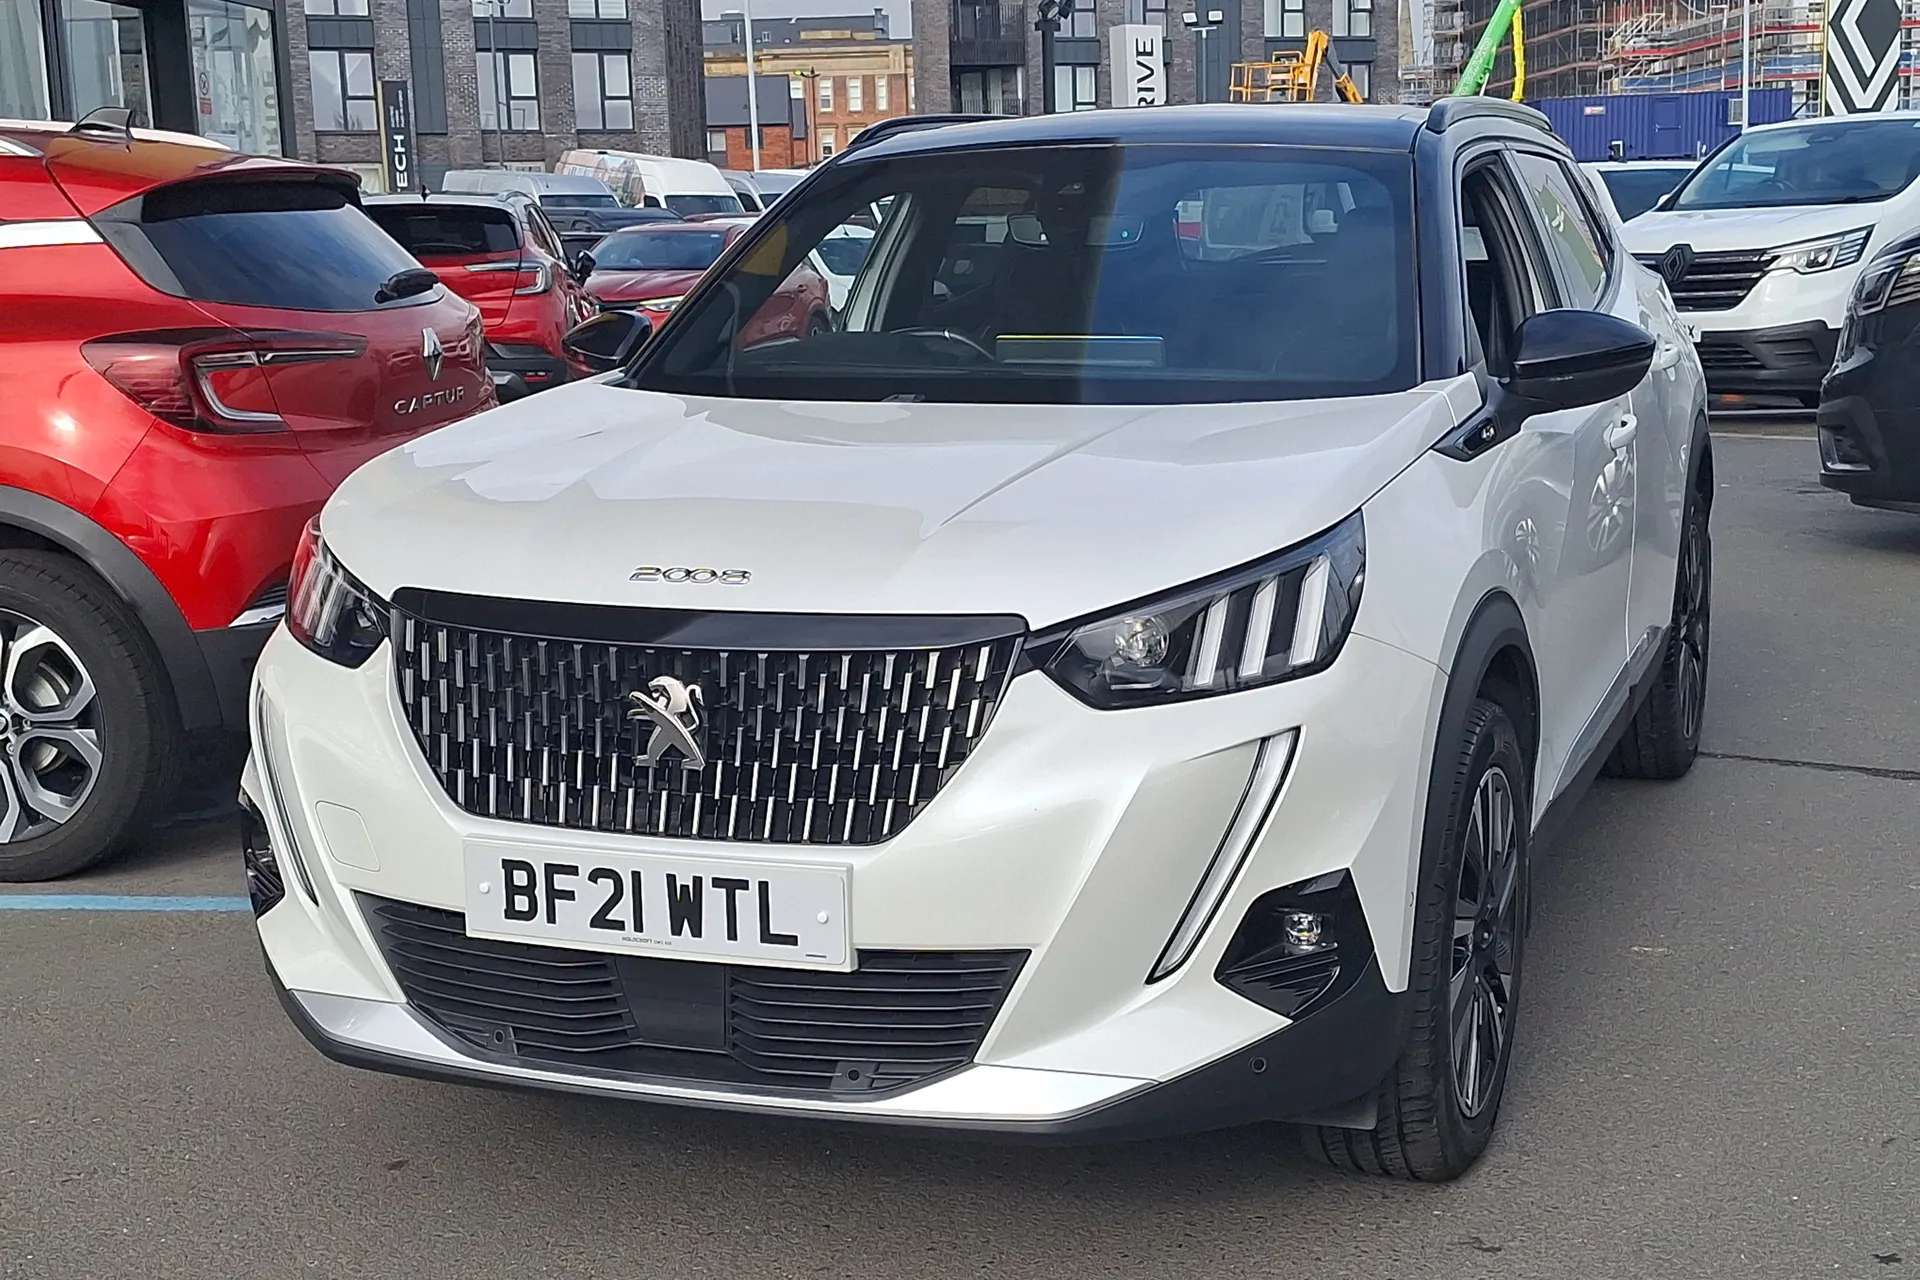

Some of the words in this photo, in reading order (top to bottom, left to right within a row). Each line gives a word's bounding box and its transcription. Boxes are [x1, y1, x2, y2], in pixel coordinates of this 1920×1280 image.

[394, 134, 408, 192] ECH
[394, 386, 464, 414] CAPTUR
[628, 566, 752, 585] 2008
[501, 858, 643, 933] BF21
[666, 873, 799, 947] WTL
